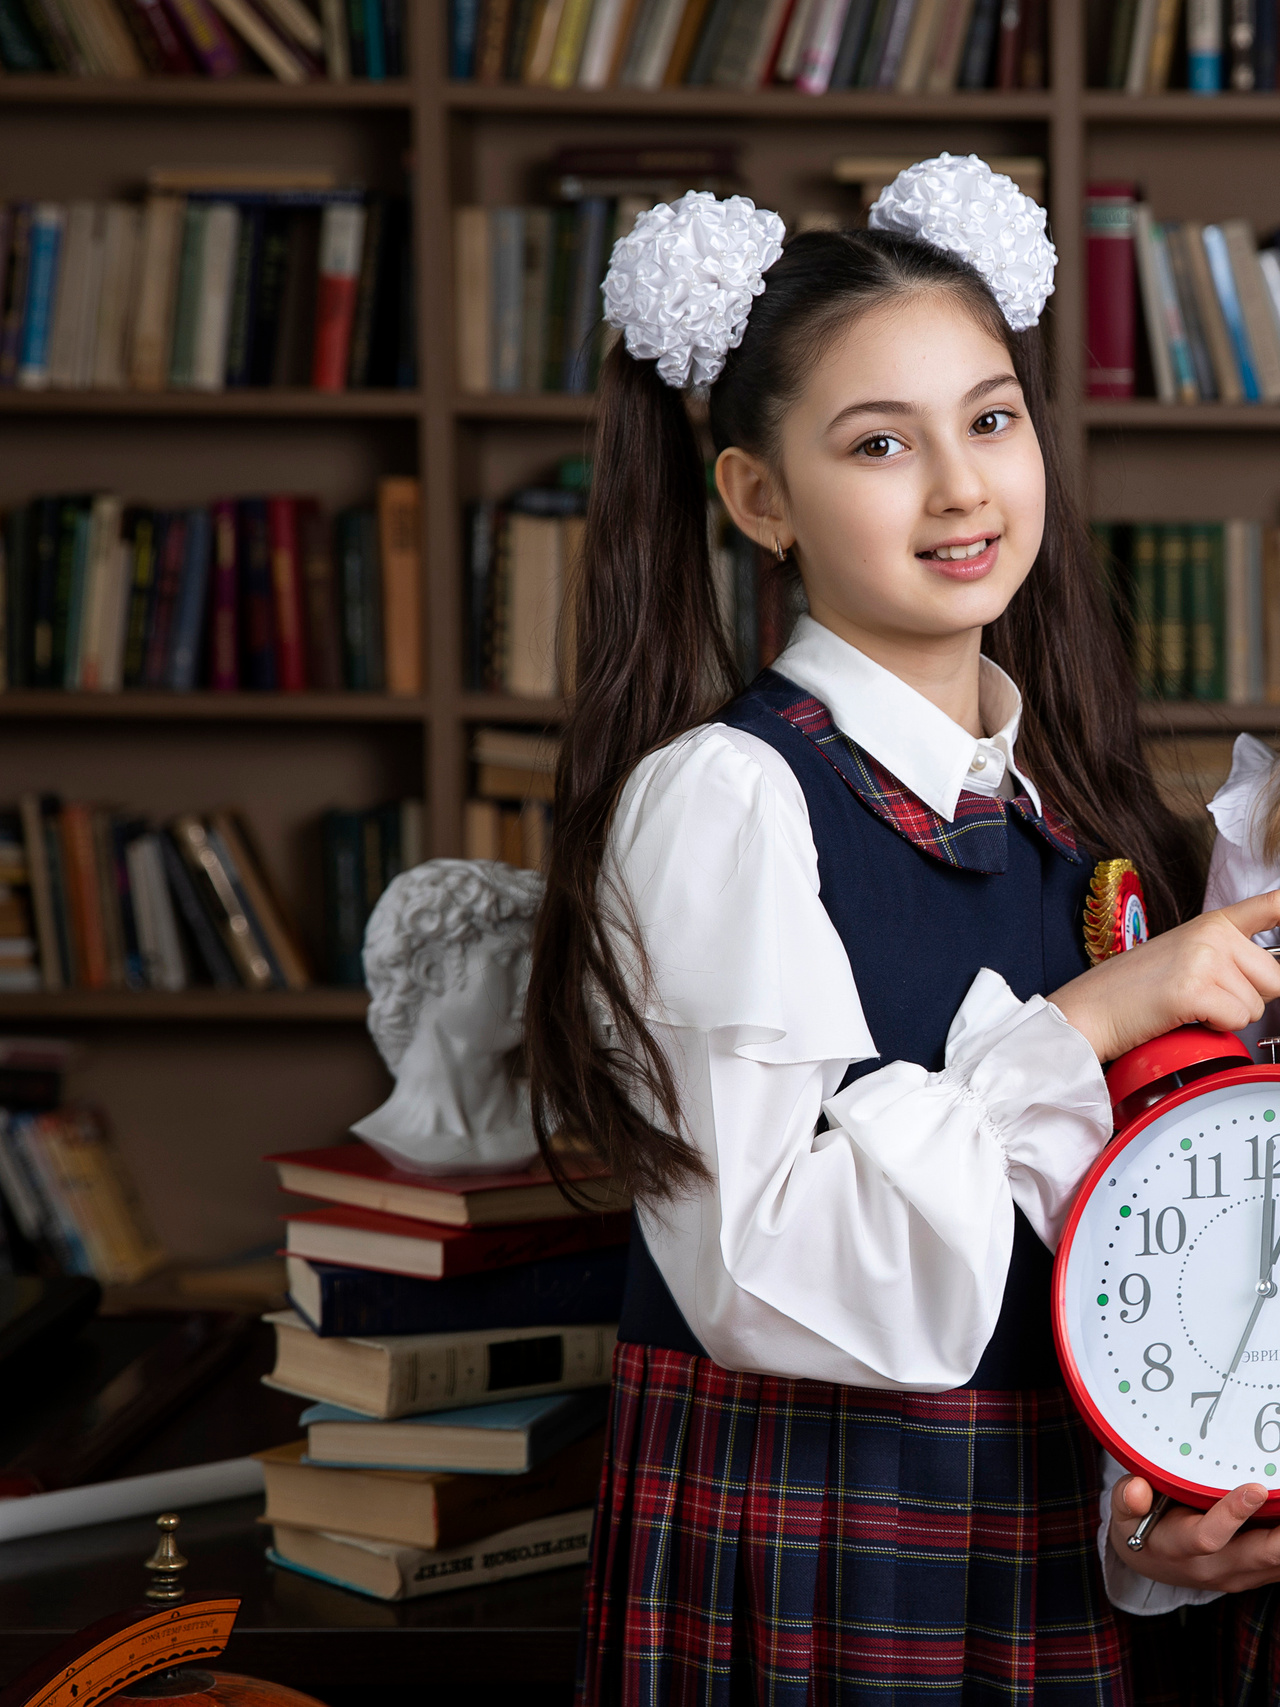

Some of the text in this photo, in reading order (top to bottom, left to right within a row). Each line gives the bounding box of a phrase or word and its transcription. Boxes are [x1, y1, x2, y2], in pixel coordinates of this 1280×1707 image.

[1182, 1152, 1231, 1200] 11
[1135, 1205, 1187, 1257] 10
[1118, 1272, 1152, 1324] 9
[1140, 1342, 1175, 1392] 8
[1190, 1390, 1222, 1440] 7
[414, 1557, 474, 1581] ВЕТЕР
